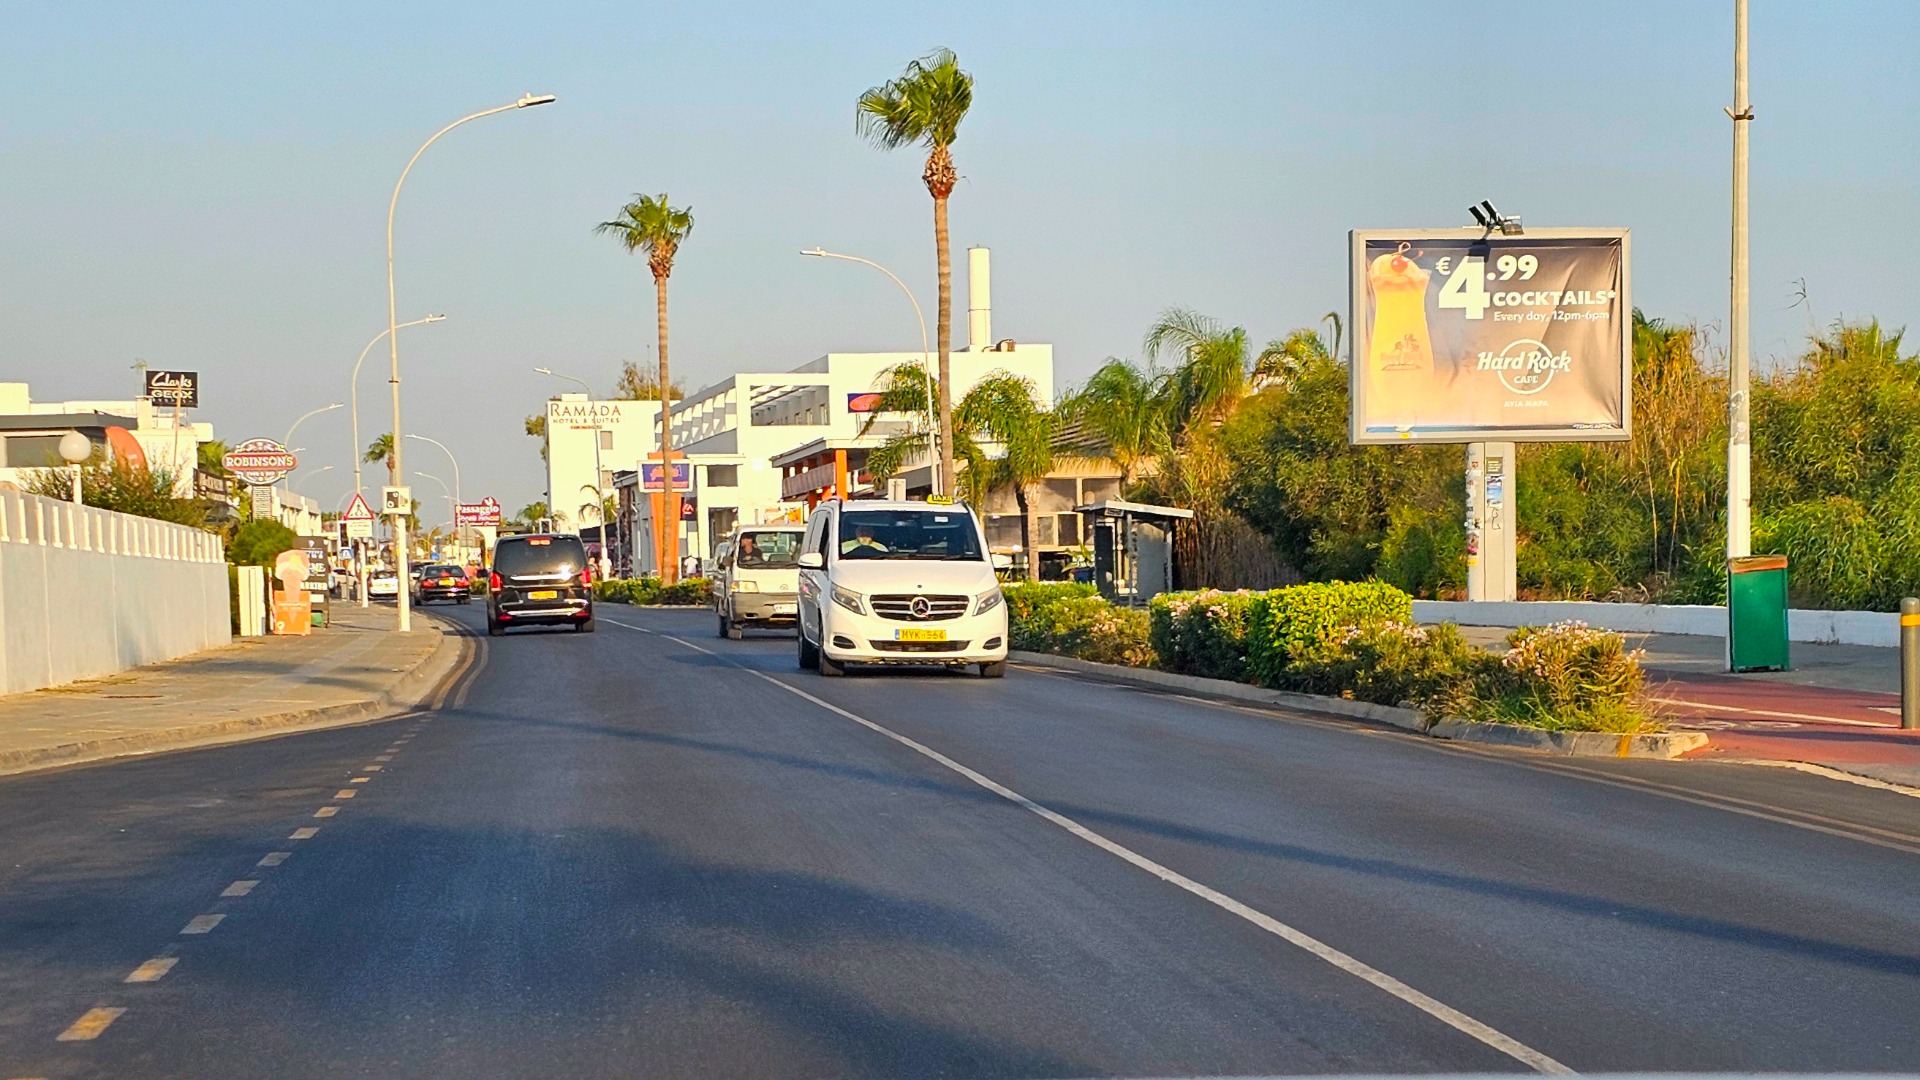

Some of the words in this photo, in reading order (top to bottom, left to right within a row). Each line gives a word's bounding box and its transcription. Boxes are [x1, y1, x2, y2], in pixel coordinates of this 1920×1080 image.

[1435, 254, 1539, 320] €4.99
[1493, 311, 1525, 323] Every
[1526, 311, 1549, 323] day,
[1553, 310, 1610, 322] 12pm-6pm
[1477, 351, 1526, 371] Hard
[1526, 350, 1572, 374] Rock
[151, 371, 193, 388] Clarks
[1513, 375, 1539, 384] CAFE
[151, 389, 193, 399] GEOX
[550, 402, 621, 417] RAMADA
[225, 454, 294, 467] ROBINSON'S
